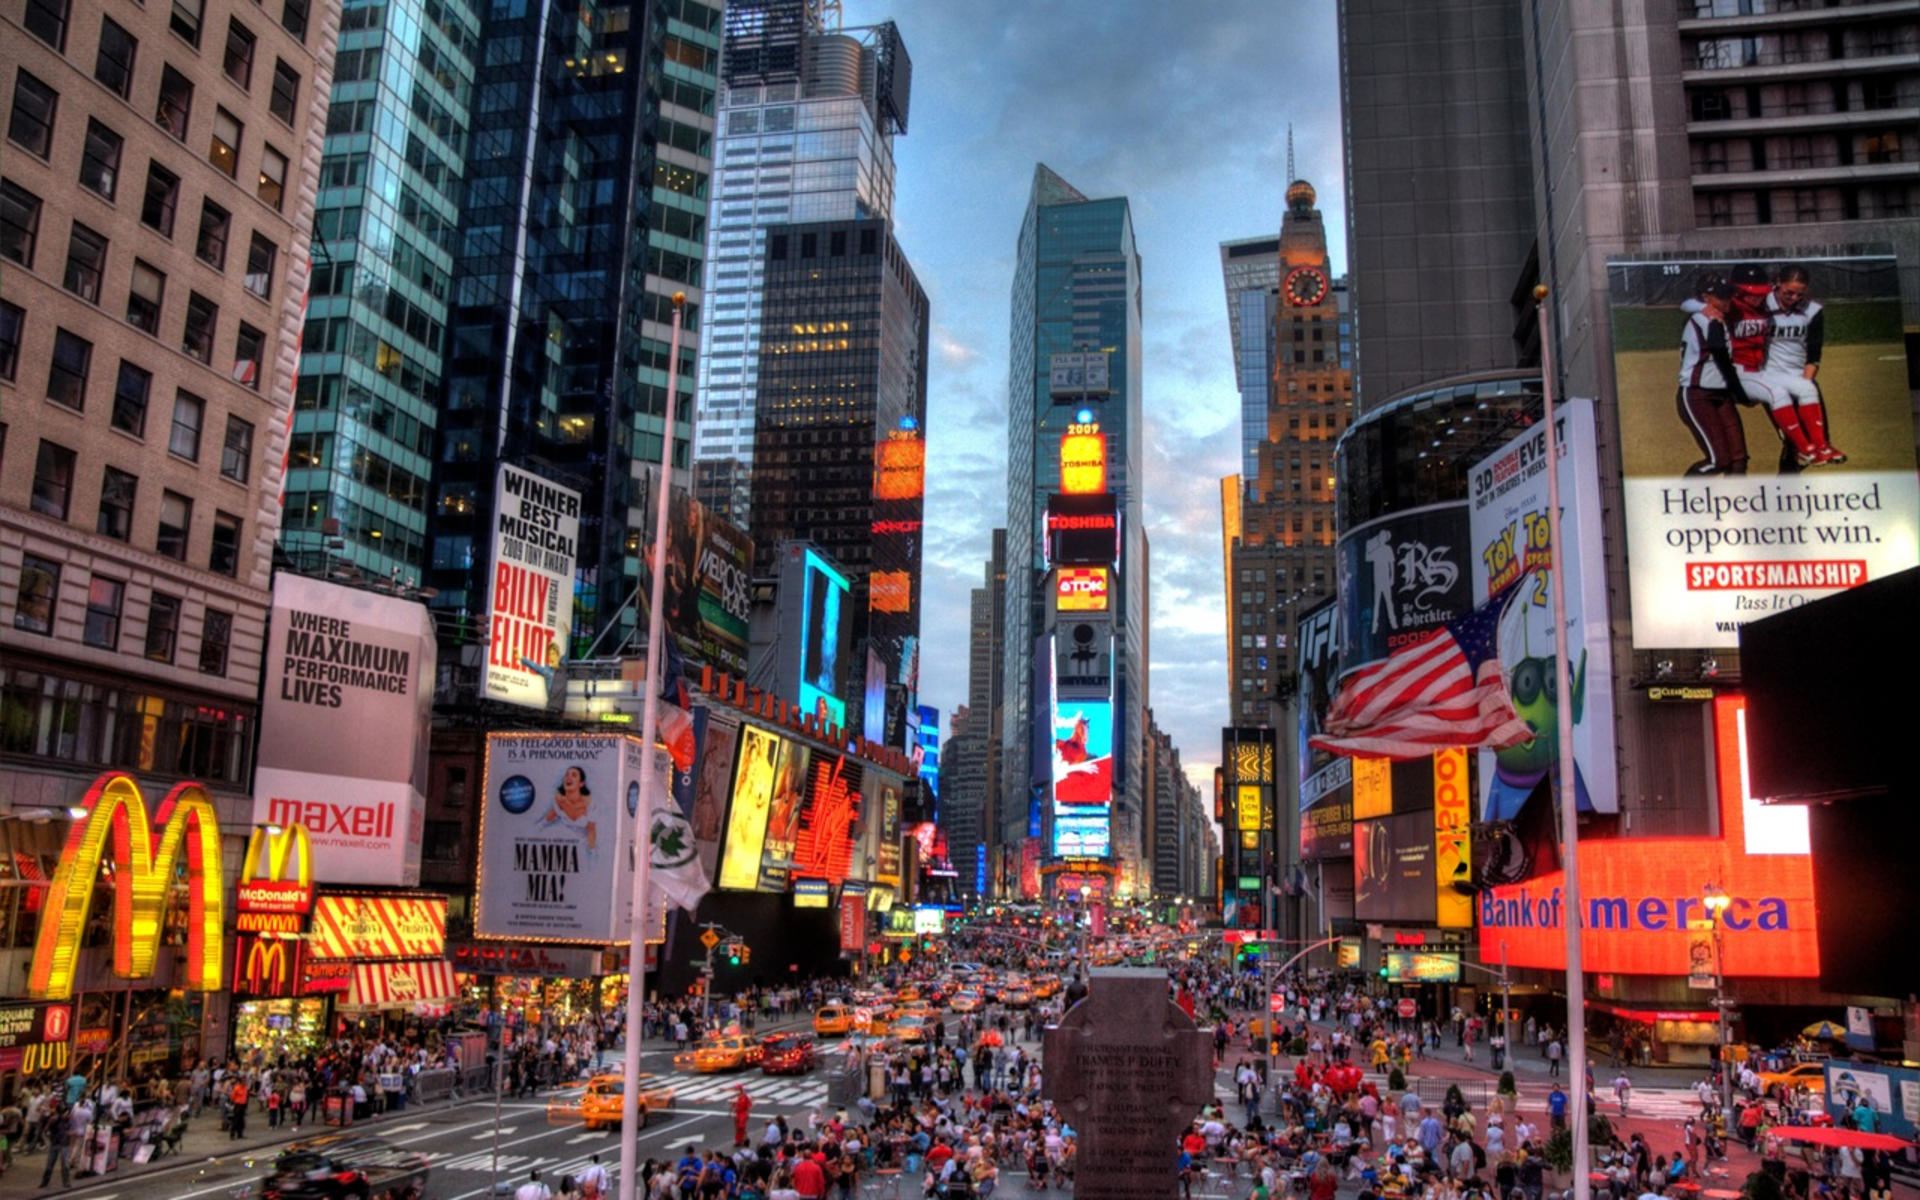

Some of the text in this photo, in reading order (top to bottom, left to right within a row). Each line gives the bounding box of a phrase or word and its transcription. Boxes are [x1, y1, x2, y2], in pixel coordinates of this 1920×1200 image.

[1663, 264, 1681, 275] 215
[1067, 424, 1099, 435] 2009
[1064, 460, 1102, 468] TOSHIBA
[1475, 417, 1566, 496] 3D EVET
[504, 469, 579, 519] WINNER
[1661, 483, 1882, 520] Helped injured
[519, 500, 562, 532] BEST
[1050, 515, 1115, 530] TOSHIBA
[499, 513, 575, 558] MUSICAL
[1483, 519, 1517, 581] TOY
[1666, 517, 1881, 553] opponent win.
[502, 537, 569, 577] 2009 TONY AWARD
[1532, 566, 1548, 609] 2
[1691, 564, 1862, 587] SPORTSMANSHIP
[494, 561, 550, 625] BILLY
[1735, 594, 1768, 610] Pass
[1772, 594, 1785, 610] It
[290, 609, 350, 638] WHERE
[285, 629, 410, 676] MAXIMUM
[489, 613, 556, 676] ELLIOT
[283, 656, 407, 695] PERFORMANCE
[280, 676, 342, 708] LIVES
[520, 749, 527, 759] A
[575, 738, 617, 749] MUSICAL
[267, 797, 395, 839] maxell
[514, 843, 579, 873] MAMMA
[239, 888, 307, 902] McDonald's
[526, 873, 565, 902] MIA!
[249, 901, 295, 910] Restaurant
[1481, 888, 1533, 928] Bank
[1538, 887, 1560, 928] of
[1140, 1055, 1183, 1068] DUFFY
